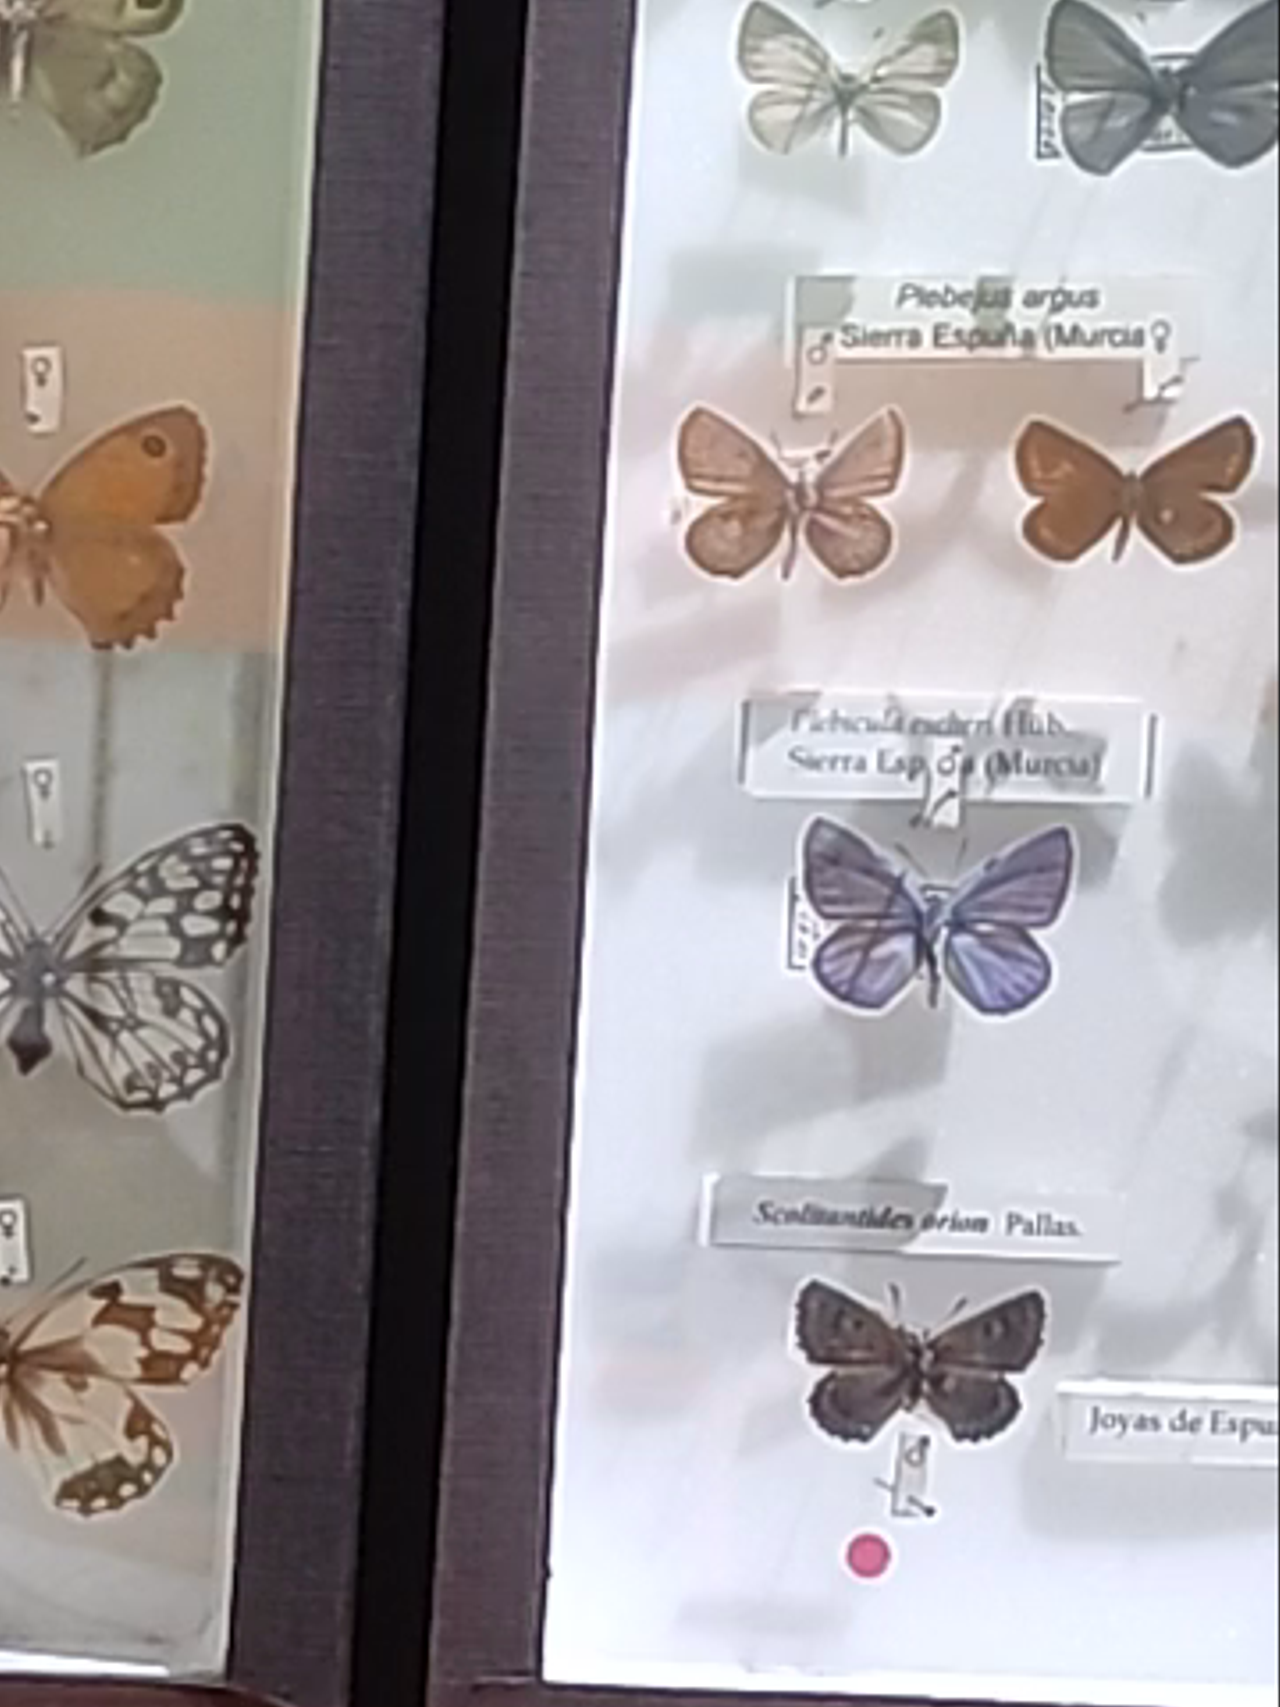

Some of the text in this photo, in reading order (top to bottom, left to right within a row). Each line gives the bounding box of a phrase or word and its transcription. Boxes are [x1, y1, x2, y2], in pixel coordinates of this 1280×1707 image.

[841, 322, 1036, 353] Sierra Espuña
[1090, 1405, 1162, 1439] Joyas
[1169, 1407, 1202, 1434] de
